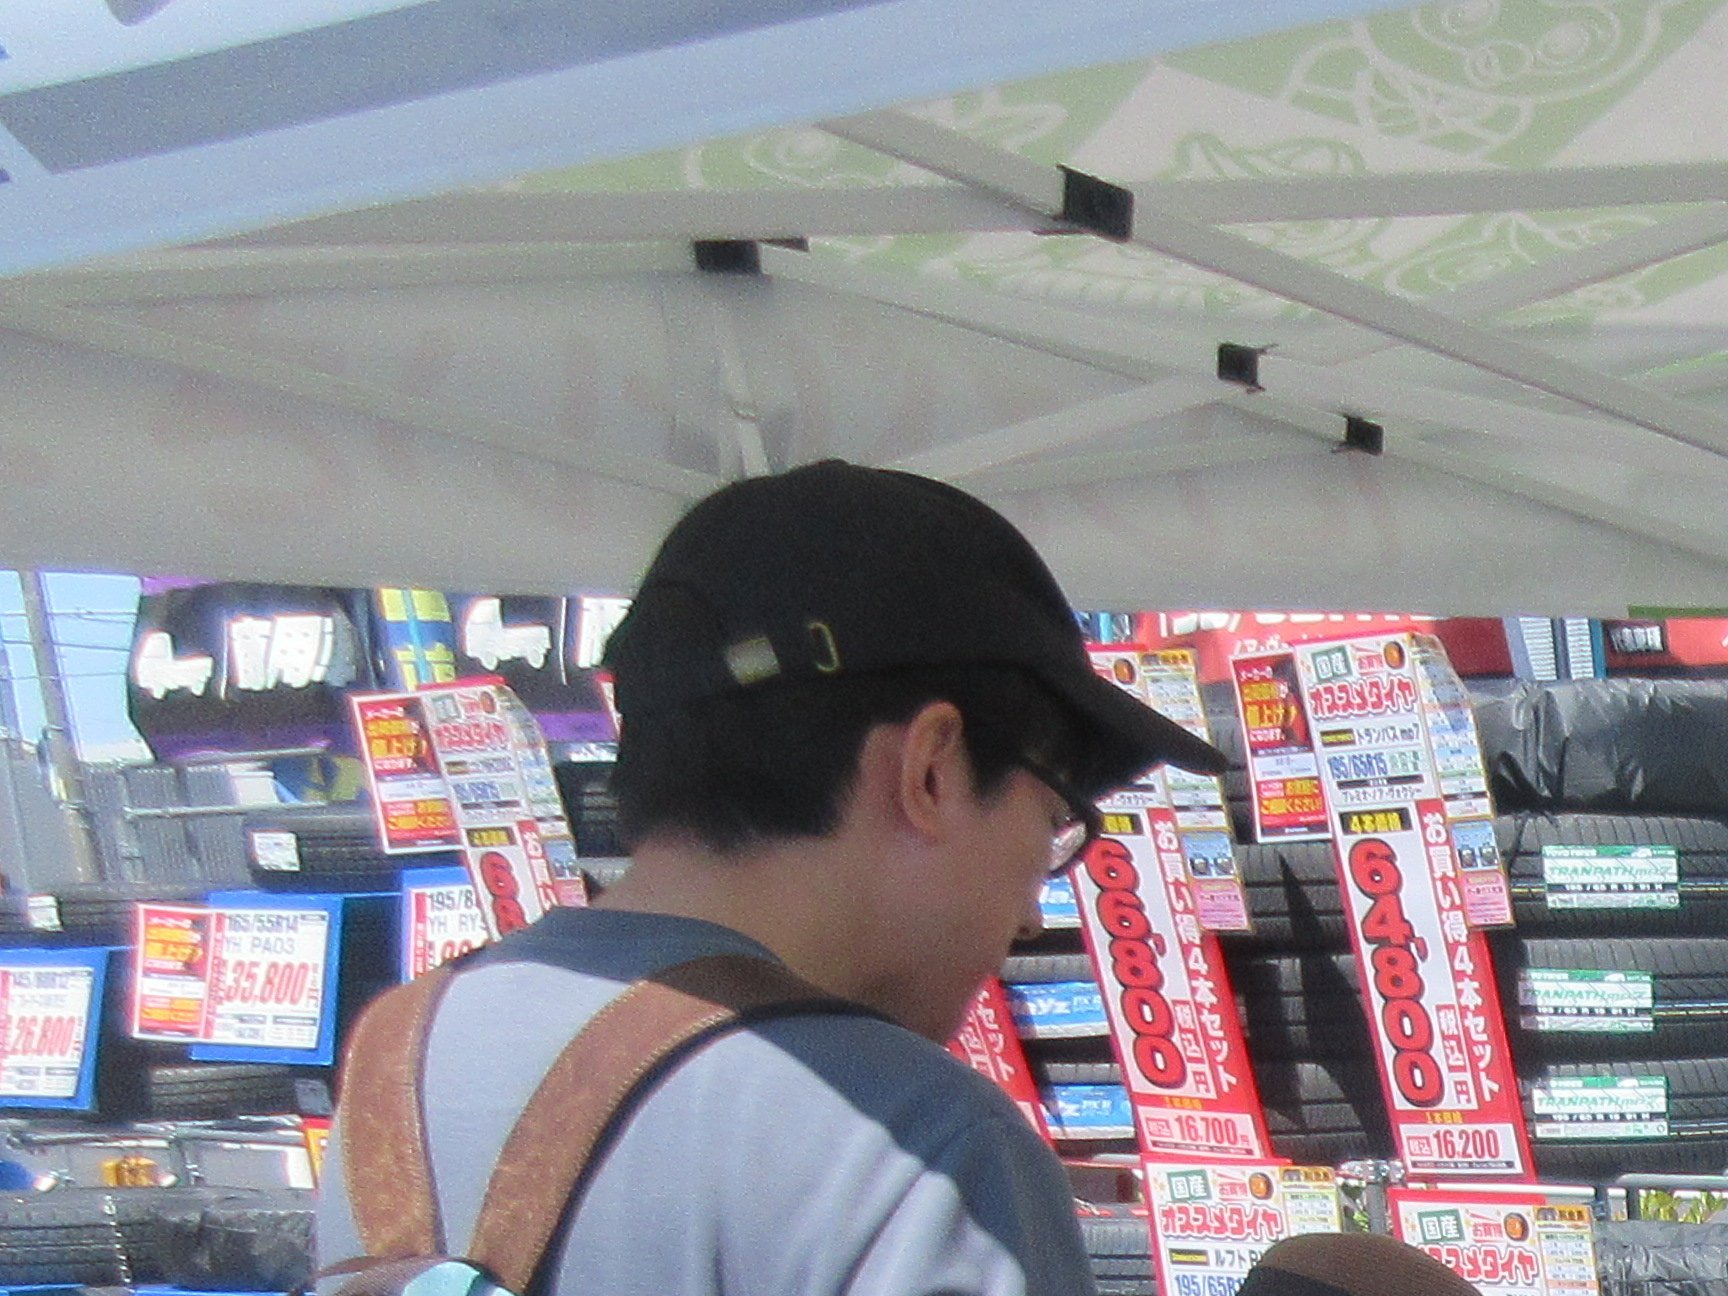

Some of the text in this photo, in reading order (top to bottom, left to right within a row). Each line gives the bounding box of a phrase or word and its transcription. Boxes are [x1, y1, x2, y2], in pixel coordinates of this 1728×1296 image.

[1310, 676, 1418, 720] オススメタイヤ
[428, 889, 474, 912] 195/8
[1084, 837, 1188, 1089] 66,800
[1350, 837, 1444, 1108] 64,800
[1423, 811, 1501, 1102] お買い得4本セット
[224, 960, 310, 1006] 35,800
[1175, 1115, 1238, 1146] 16,700
[1432, 1129, 1500, 1160] 16,200
[1172, 1176, 1208, 1200] 国産
[1160, 1202, 1283, 1239] オススメタイヤ
[1422, 1214, 1459, 1240] 国産
